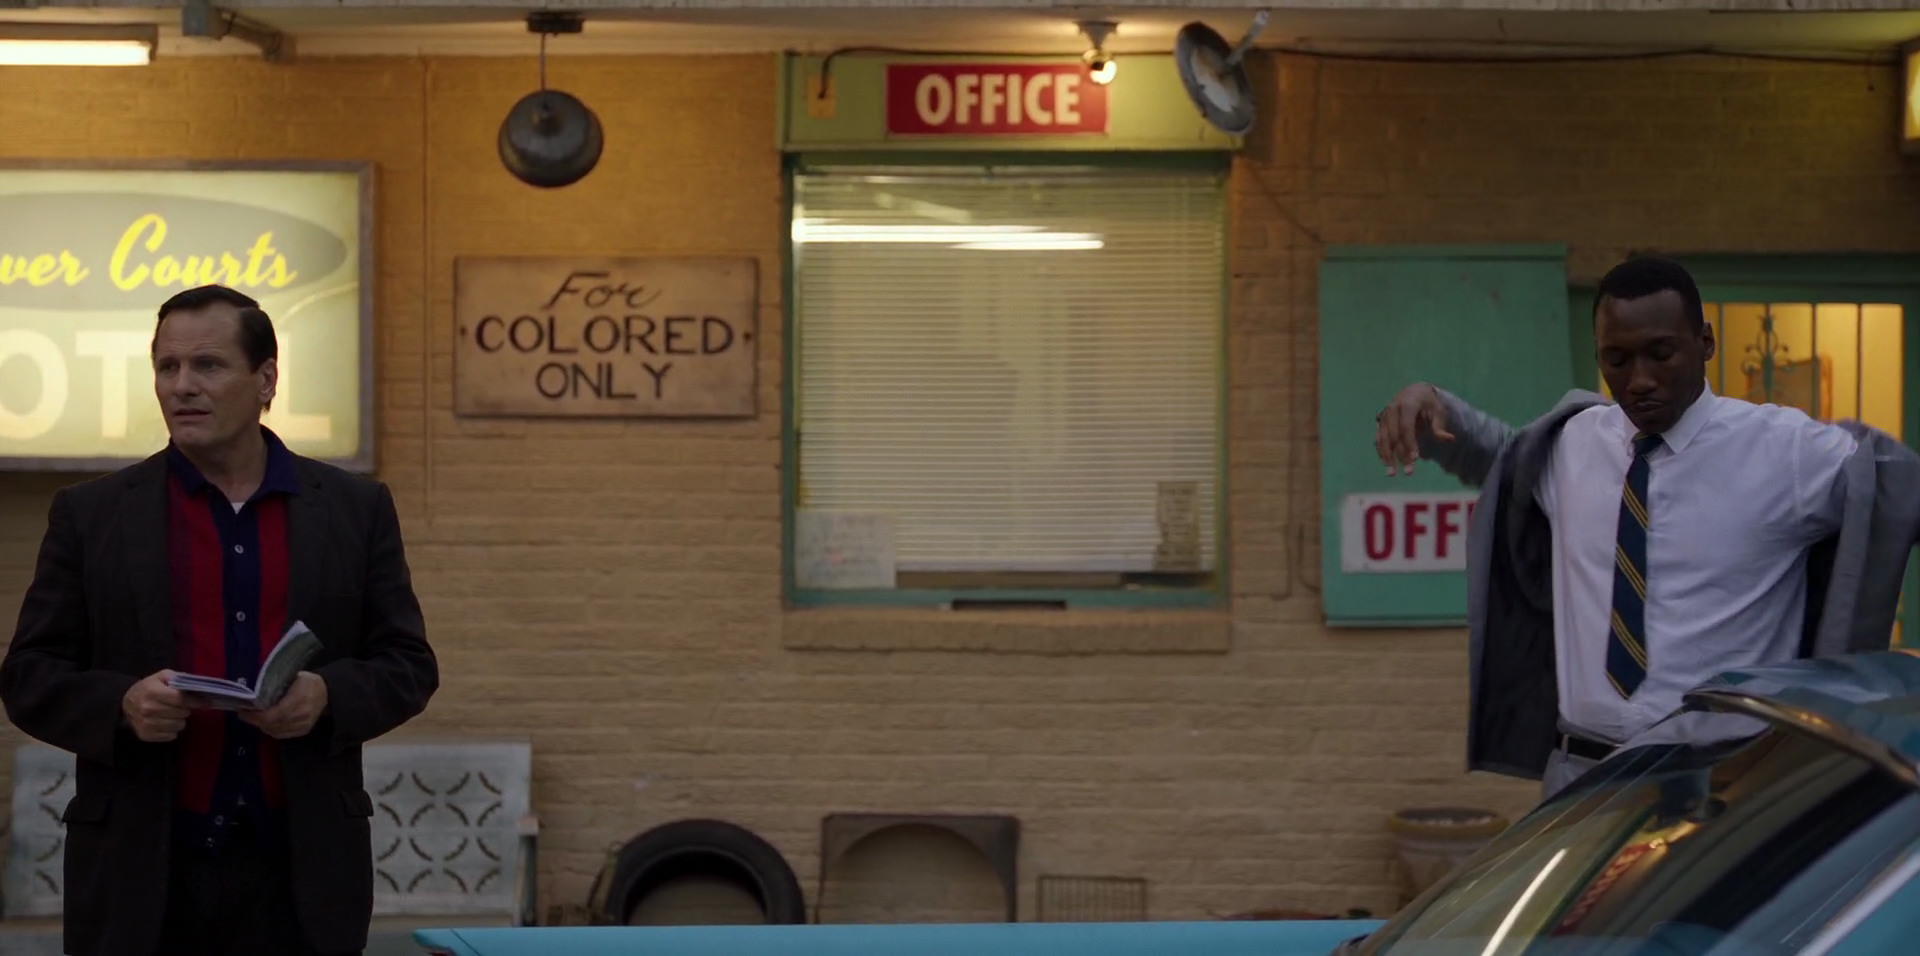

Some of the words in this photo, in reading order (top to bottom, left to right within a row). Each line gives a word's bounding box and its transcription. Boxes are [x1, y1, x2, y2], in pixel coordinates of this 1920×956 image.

[915, 73, 1082, 125] OFFICE
[109, 213, 297, 291] Courts
[542, 270, 662, 310] For
[475, 315, 734, 355] COLORED
[0, 328, 331, 440] OTL
[535, 362, 672, 400] ONLY
